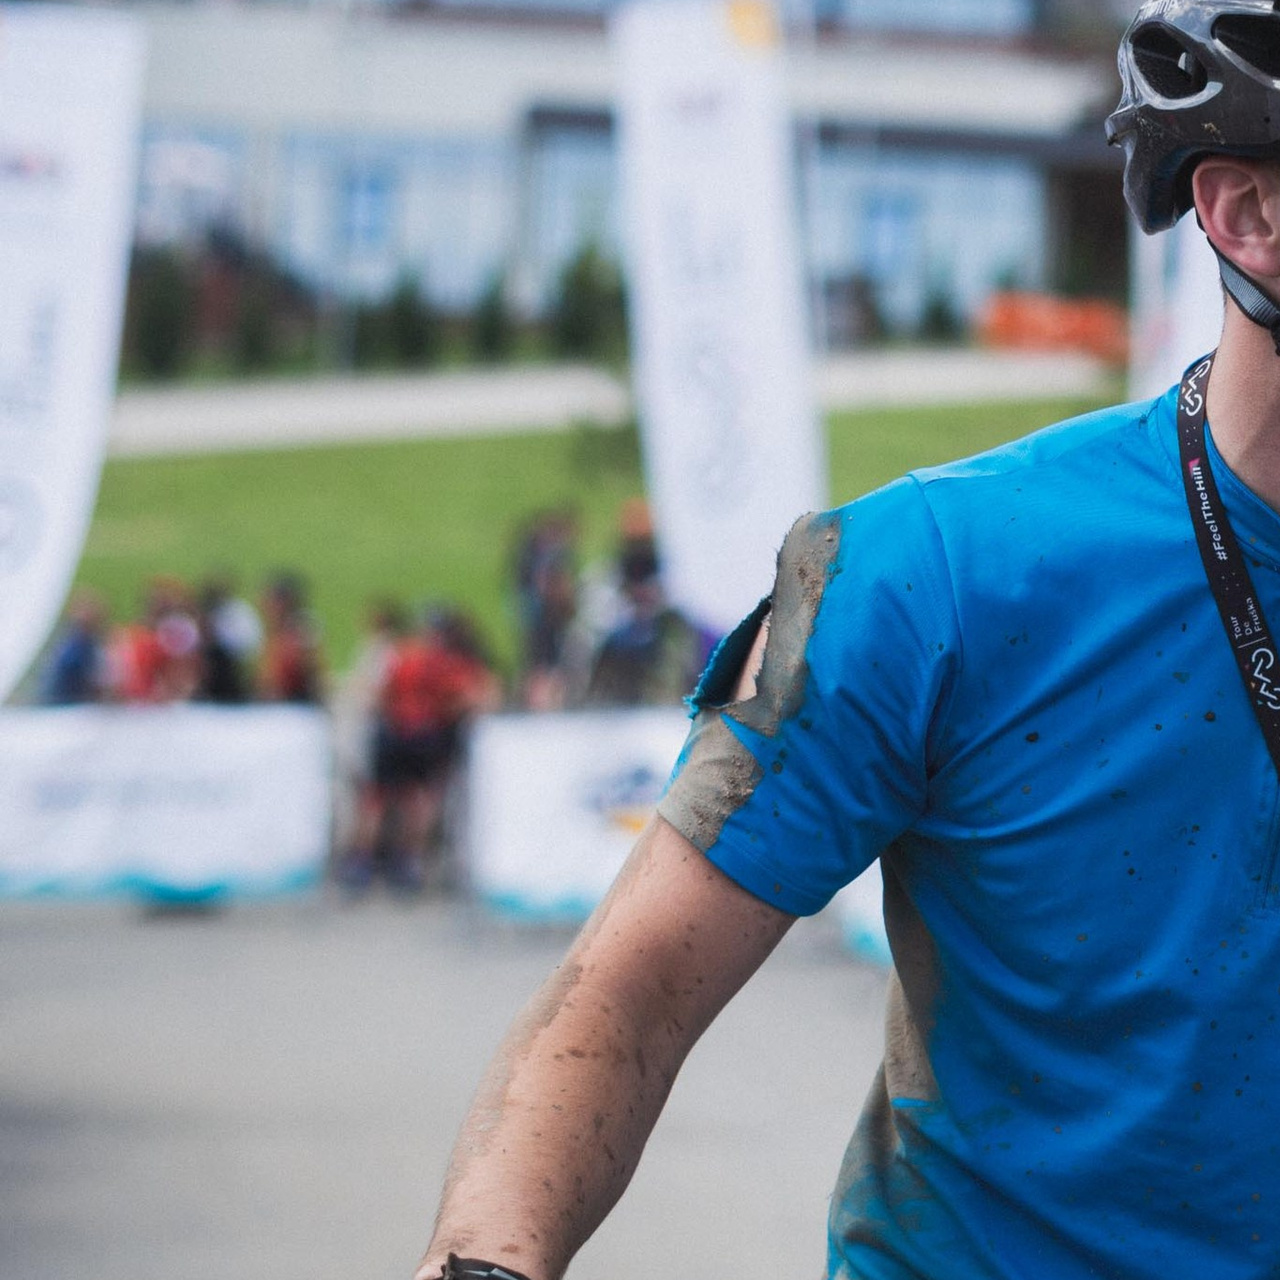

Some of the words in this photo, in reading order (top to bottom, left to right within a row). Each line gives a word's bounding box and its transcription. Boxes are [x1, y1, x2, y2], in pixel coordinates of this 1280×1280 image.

[1192, 466, 1228, 561] #FeelTheHill
[1230, 616, 1243, 639] Tour
[1243, 621, 1253, 636] De
